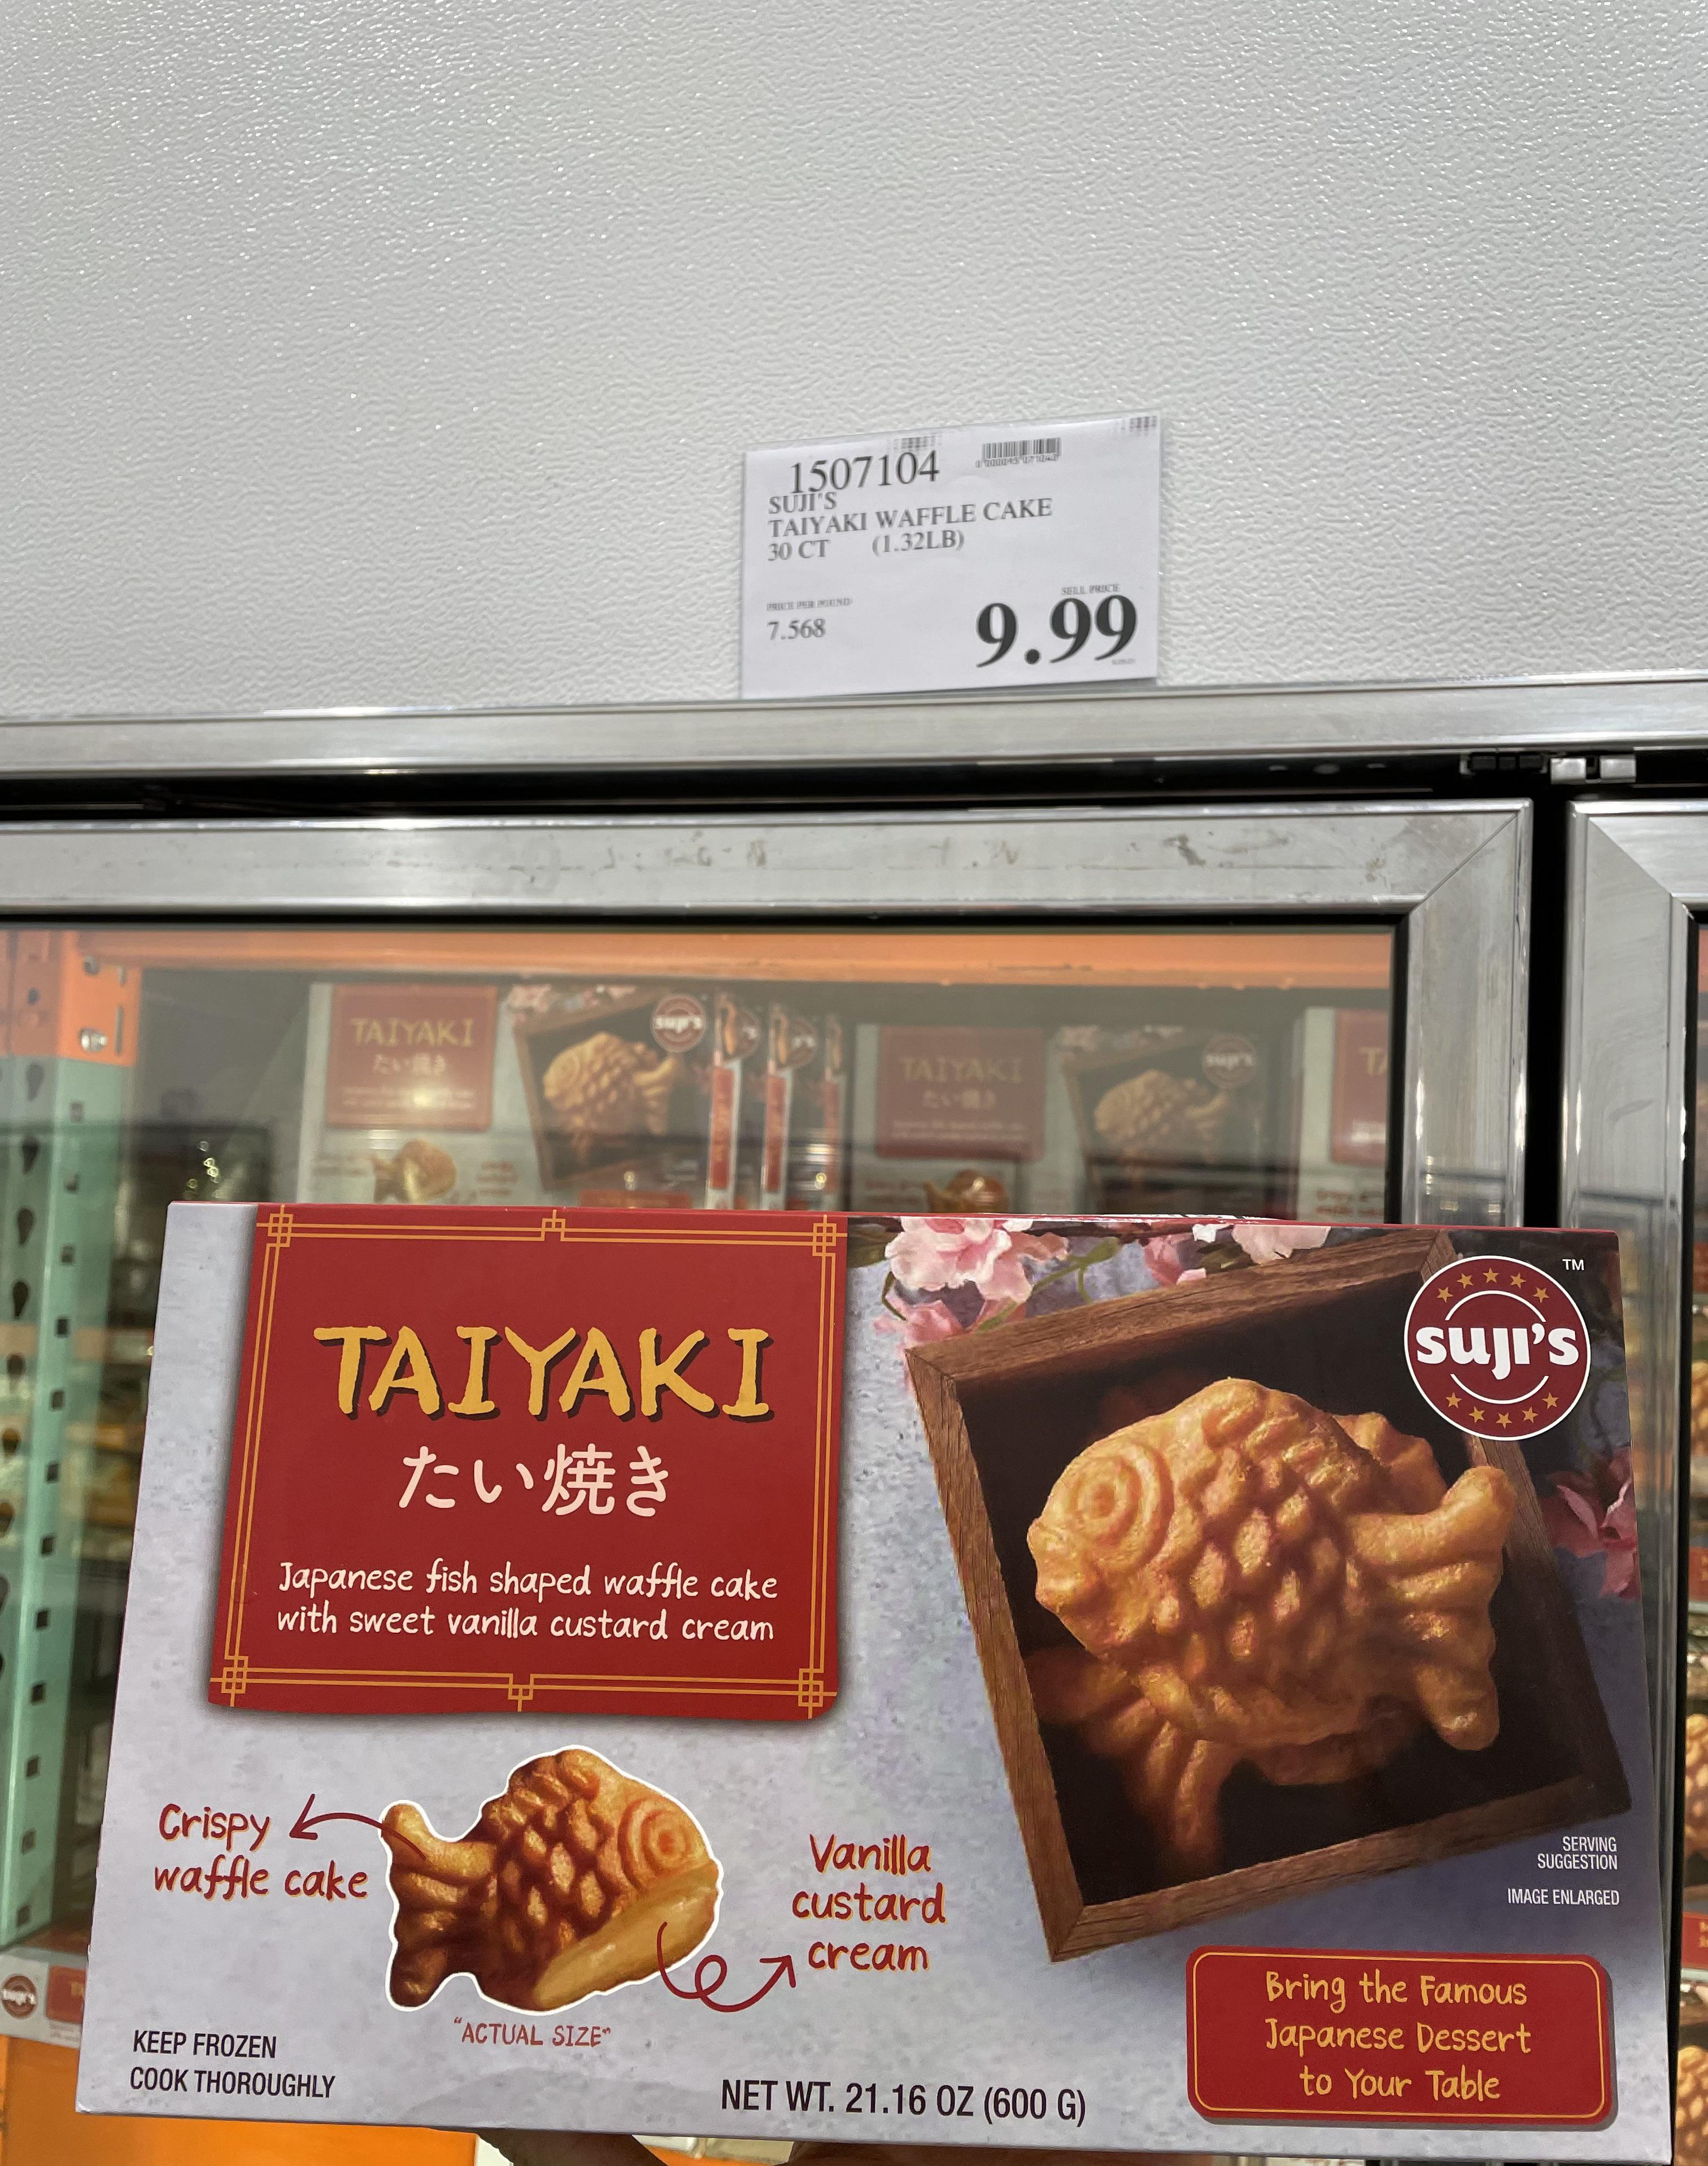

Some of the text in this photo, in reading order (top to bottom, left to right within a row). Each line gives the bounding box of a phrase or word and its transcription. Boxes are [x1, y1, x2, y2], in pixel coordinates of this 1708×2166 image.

[791, 450, 940, 493] 1507104
[768, 491, 837, 514] SUJI'S
[768, 498, 1053, 537] TAIYAKI WAFFLE CAKE
[768, 529, 965, 561] 30 CT (1.32LB)
[766, 598, 852, 611] PRICE PER POUND
[1061, 584, 1120, 595] SELL PRICE
[767, 618, 826, 641] 7.568
[976, 595, 1138, 667] 9.99
[350, 1017, 473, 1047] TAIYAKI
[1562, 1259, 1584, 1271] TM
[1416, 1323, 1579, 1380] suji's
[314, 1326, 772, 1419] TAIYAKI
[399, 1443, 669, 1517] たい焼き
[280, 1559, 778, 1603] Japanese fish shaped waffle cake
[277, 1601, 774, 1641] with sweet vanilla custard cream
[159, 1804, 271, 1851] Crispy
[1562, 1836, 1617, 1852] SERVING
[809, 1834, 931, 1874] Vanilla
[1537, 1854, 1618, 1870] SUGGESTION
[155, 1855, 368, 1900] waffle cake
[792, 1882, 946, 1923] custard
[1507, 1888, 1620, 1906] IMAGE ENLARGED
[809, 1941, 929, 1971] cream
[1266, 1969, 1527, 2013] Bring the Famous
[133, 2030, 277, 2059] KEEP FROZEN
[454, 2017, 611, 2047] "ACTUAL SIZE"
[1265, 2019, 1532, 2057] Japanese Dessert
[130, 2067, 336, 2098] COOK THOROUGHLY
[1300, 2065, 1500, 2101] to Your Table
[721, 2079, 1086, 2126] NET WT. 21.16 OZ (600 G)
